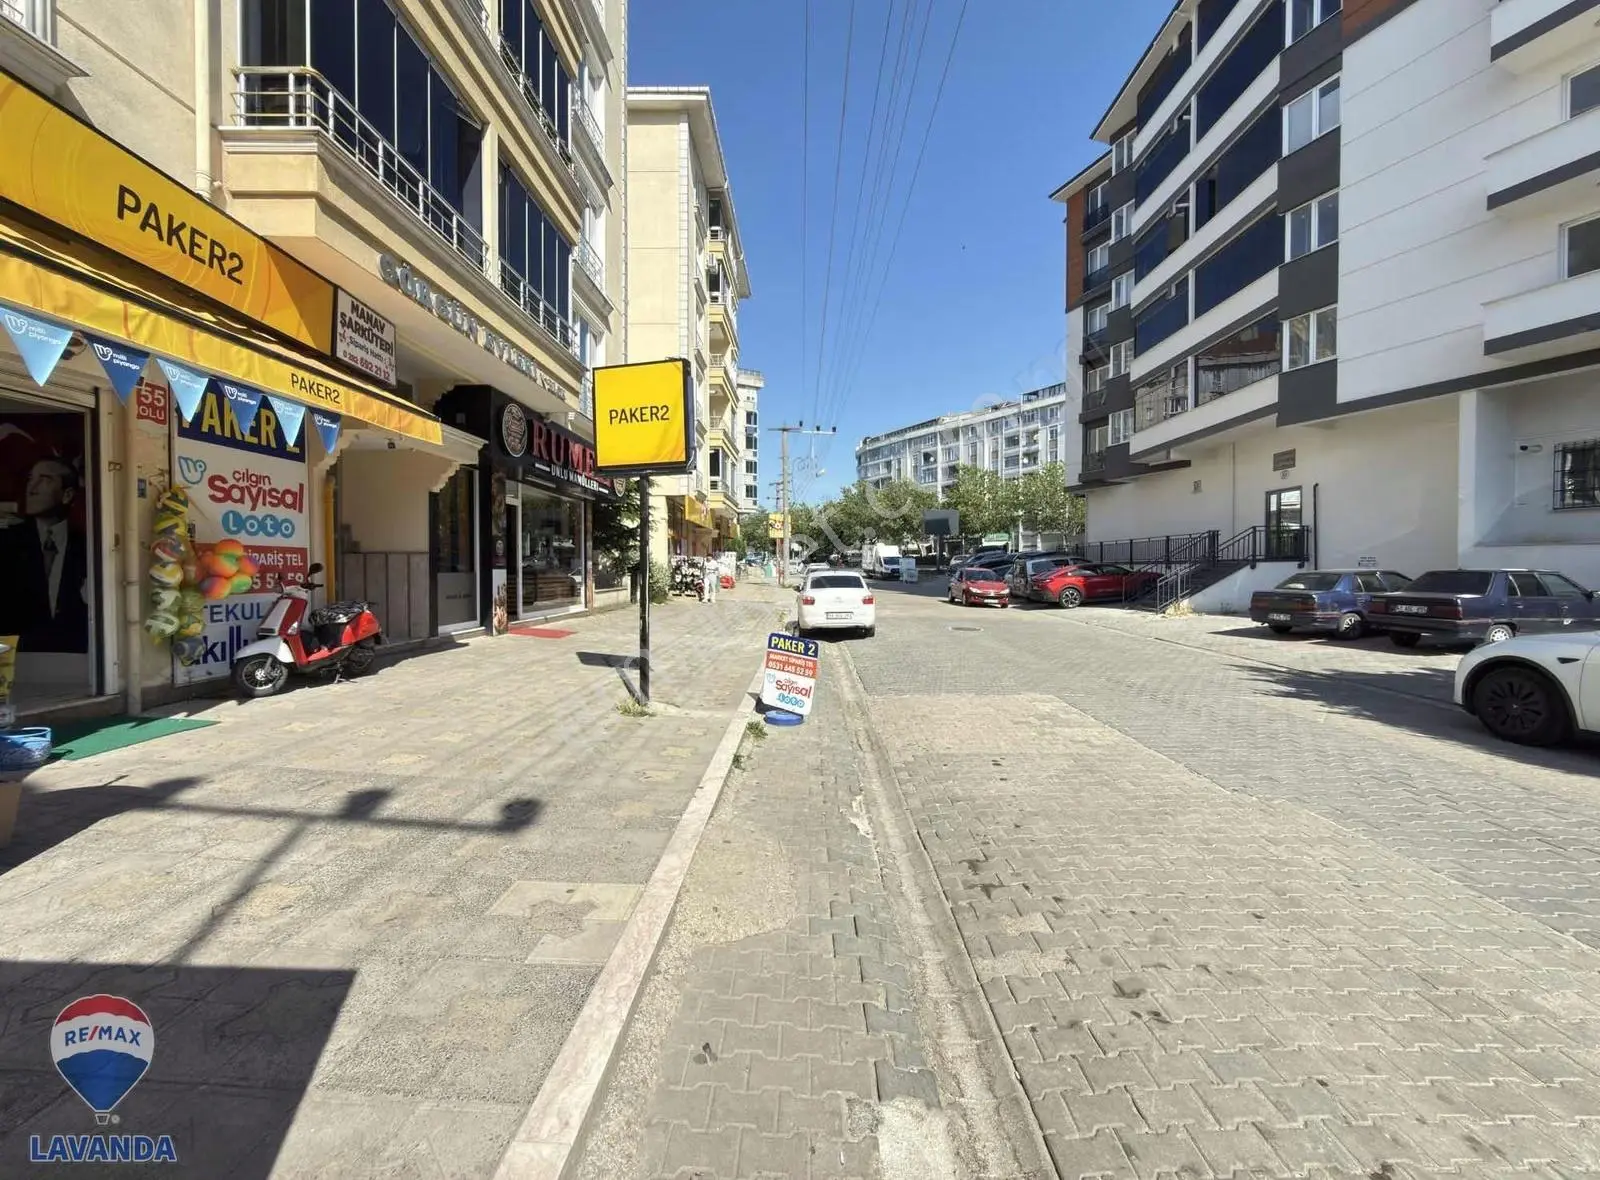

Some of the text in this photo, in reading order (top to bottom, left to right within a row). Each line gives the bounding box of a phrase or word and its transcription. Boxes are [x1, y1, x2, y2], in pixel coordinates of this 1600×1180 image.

[116, 184, 244, 286] PAKER2
[350, 300, 385, 335] MANAV
[113, 351, 128, 361] milli
[113, 358, 140, 371] piyango
[291, 372, 341, 405] PAKER2
[609, 405, 670, 425] PAKER2
[232, 469, 271, 486] çılgın
[208, 474, 304, 514] Sayısal
[286, 553, 303, 566] TEL
[203, 602, 264, 623] EKUL
[771, 636, 816, 656] PAKER 2
